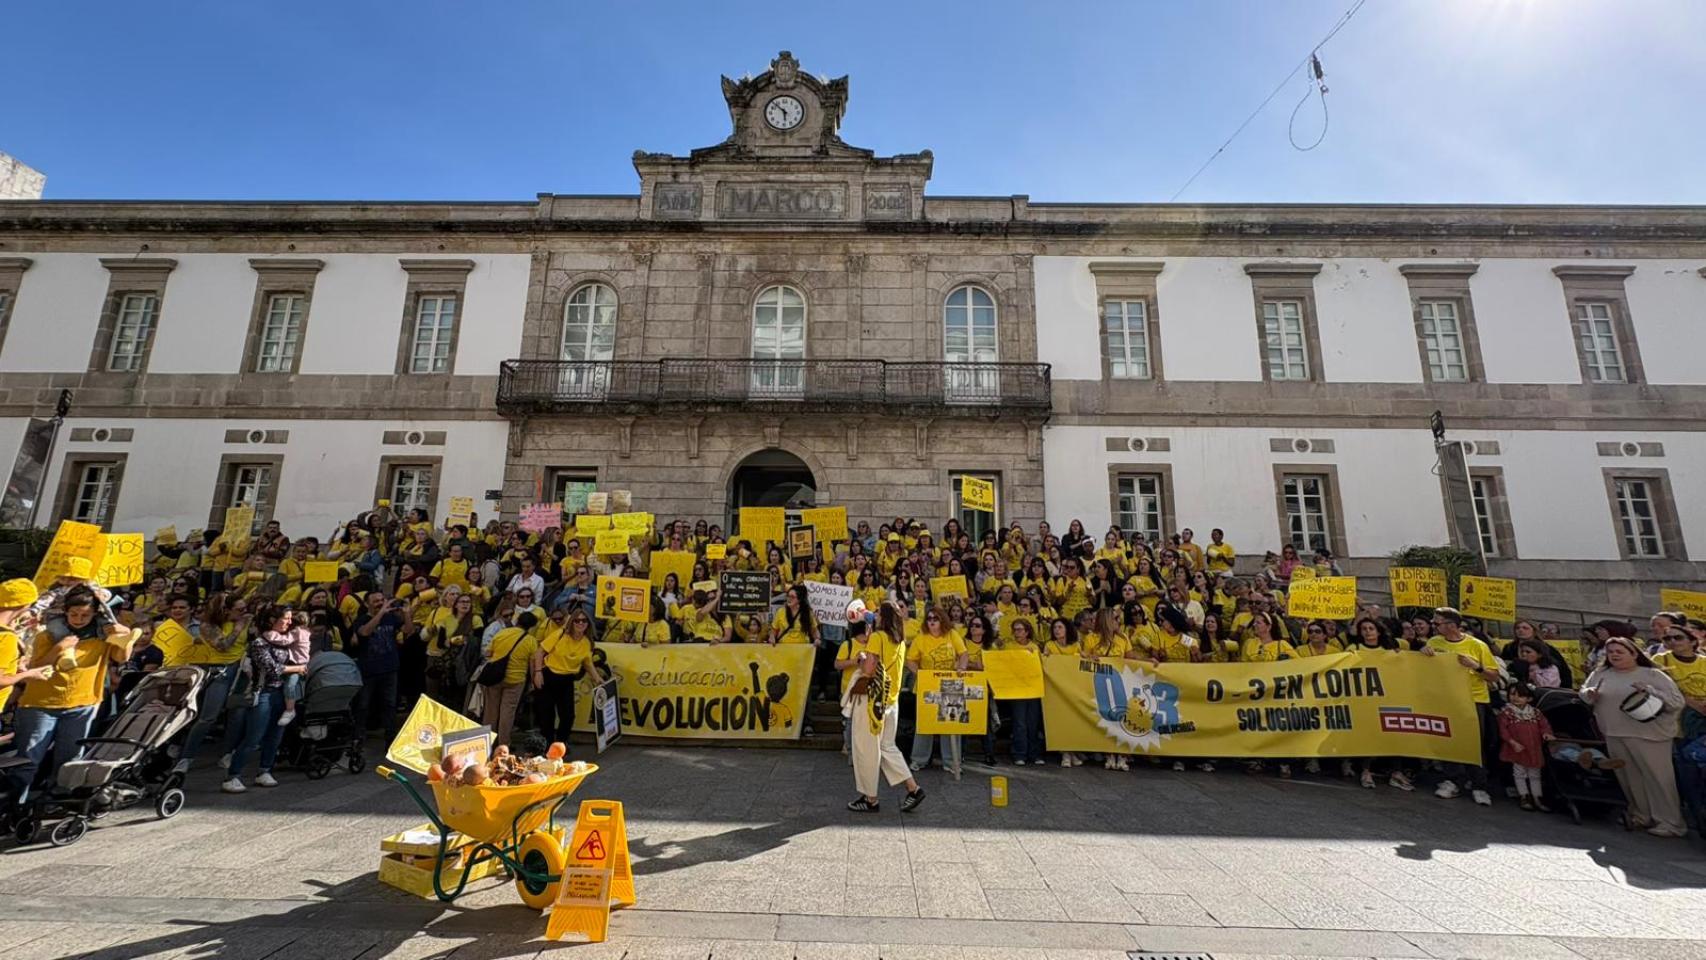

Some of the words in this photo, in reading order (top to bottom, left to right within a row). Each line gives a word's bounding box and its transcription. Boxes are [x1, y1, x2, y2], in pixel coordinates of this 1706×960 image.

[730, 189, 834, 213] MARCO
[807, 583, 838, 595] SOMOS
[840, 589, 850, 597] LA
[637, 656, 736, 687] educación
[1248, 678, 1265, 700] 3
[1274, 674, 1304, 700] EN
[1312, 667, 1384, 699] LOITA
[589, 688, 770, 732] EVOLUCIÓN
[1237, 703, 1321, 732] SOLUCIÓNS
[1324, 704, 1352, 730] XA!
[1384, 715, 1446, 733] CCOO
